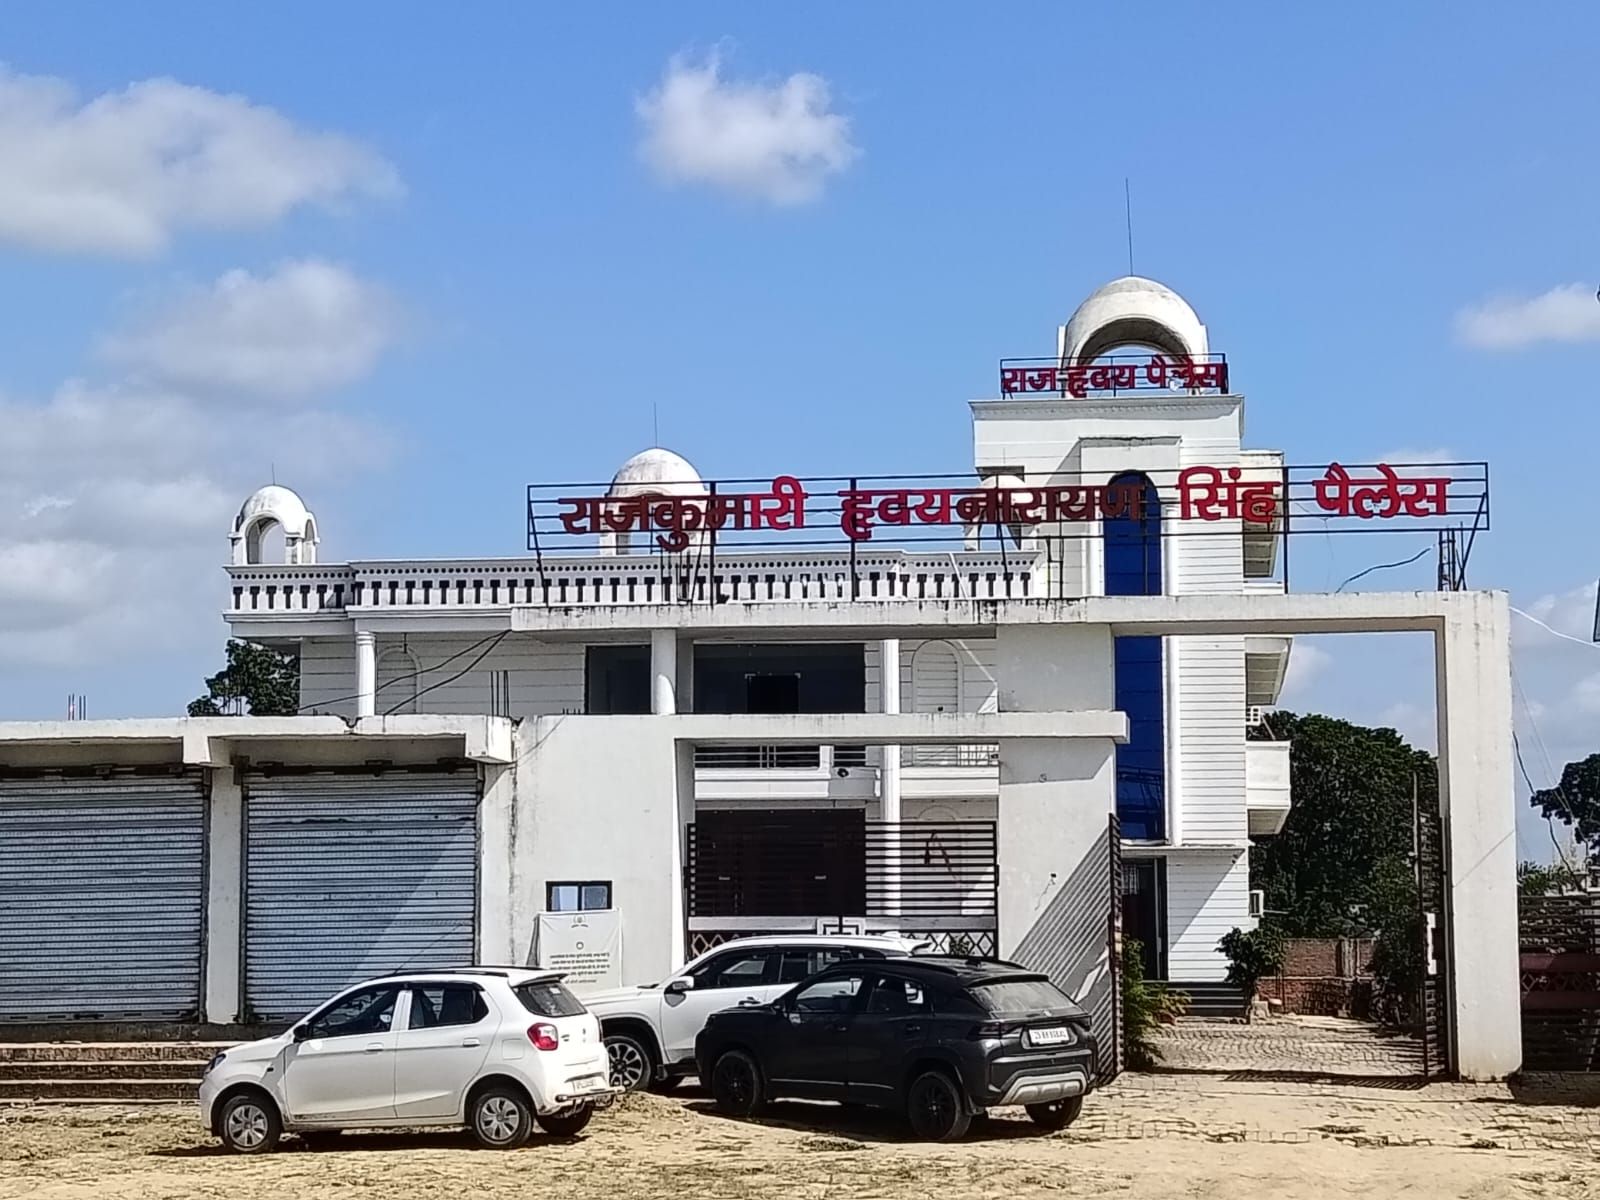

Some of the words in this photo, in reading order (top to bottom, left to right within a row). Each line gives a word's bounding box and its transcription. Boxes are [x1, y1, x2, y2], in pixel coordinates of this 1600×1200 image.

[1001, 368, 1057, 393] राज
[558, 475, 808, 552] राजकुमारी
[1176, 465, 1281, 523] सिंह
[1311, 461, 1452, 519] पैलेस
